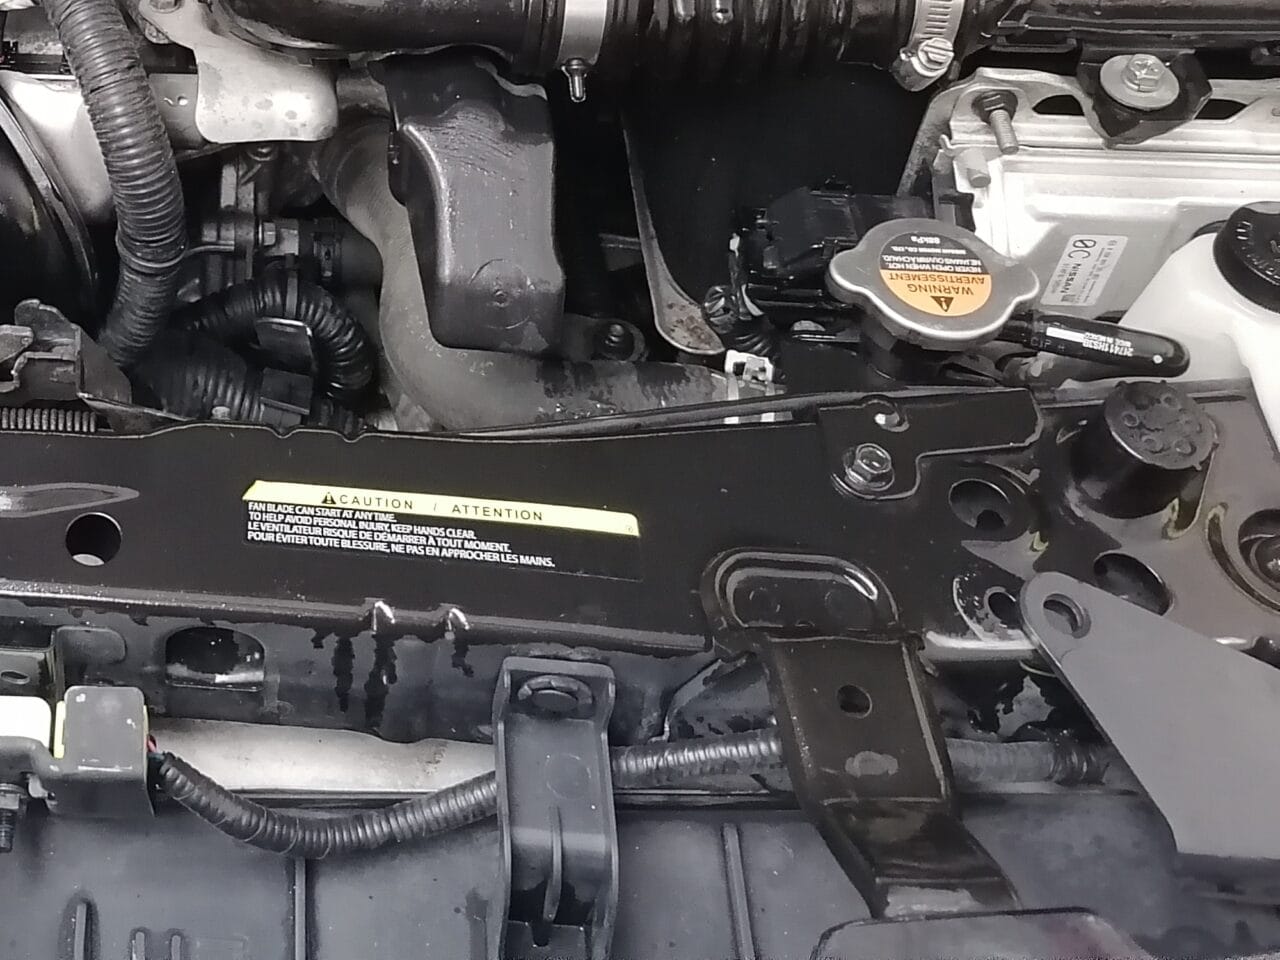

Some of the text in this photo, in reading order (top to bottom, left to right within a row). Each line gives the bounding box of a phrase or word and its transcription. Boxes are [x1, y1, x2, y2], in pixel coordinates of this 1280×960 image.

[906, 263, 931, 271] WHEN
[931, 264, 955, 272] OPEN
[954, 265, 982, 273] NEVER
[889, 272, 985, 285] AVERTISSEMENT
[1060, 263, 1082, 294] NISSAN
[907, 283, 974, 296] WARNING
[248, 501, 266, 513] FAN
[266, 503, 295, 515] BLADE
[295, 505, 315, 516] CAN
[316, 507, 342, 518] START
[342, 509, 354, 518] AT
[339, 494, 413, 510] CAUTION
[452, 504, 543, 521] ATTENTION
[249, 511, 477, 540] TO HELP AVOID PERSONAL INJURY, KEEP HANDS CLEAR.
[248, 521, 261, 531] LE
[260, 522, 321, 536] VENTILATEUR
[322, 528, 358, 540] RISQUE
[358, 530, 373, 540] DE
[373, 531, 427, 546] DÉMARRER
[436, 537, 463, 548] TOUT
[463, 540, 512, 553] MOMENT.
[247, 530, 556, 567] POUR ÉVITER TOUTE BLESSURE, NE PAS EN APPROCHER LES MAINS.
